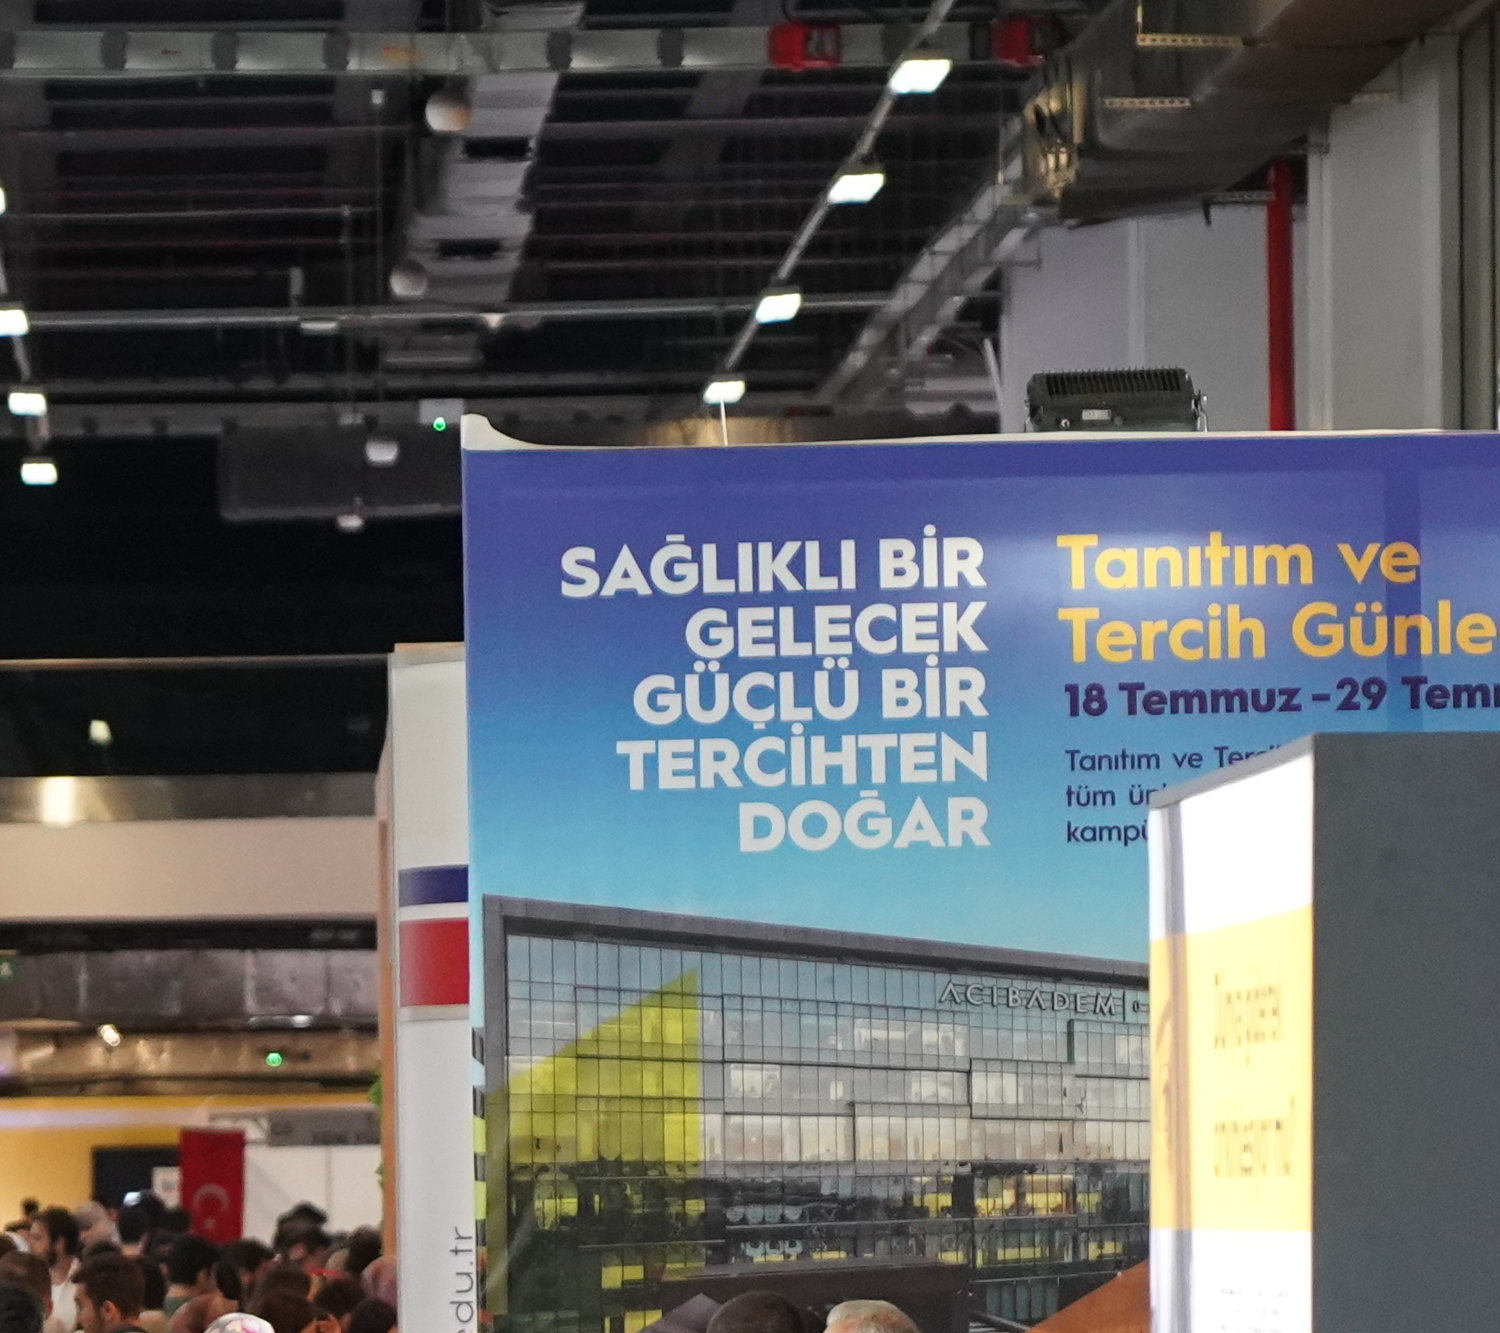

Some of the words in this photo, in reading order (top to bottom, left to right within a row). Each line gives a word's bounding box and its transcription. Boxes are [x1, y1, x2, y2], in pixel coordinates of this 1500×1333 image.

[561, 534, 857, 597] SAĞLIKLI
[880, 525, 986, 588] BİR
[1057, 531, 1312, 590] Tanıtım
[1337, 541, 1421, 584] ve
[686, 602, 987, 659] GELECEK
[1057, 604, 1265, 664] Tercih
[633, 658, 859, 729] GÜÇLÜ
[882, 655, 986, 719] BİR
[1064, 682, 1108, 717] 18
[1119, 680, 1302, 715] Temmuz
[617, 723, 987, 791] TERCİHTEN
[1065, 748, 1160, 771] Tanıtım
[1173, 752, 1203, 768] ve
[740, 792, 989, 851] DOĞAR
[1066, 785, 1115, 806] tüm
[939, 981, 1116, 1016] ACIBADEM
